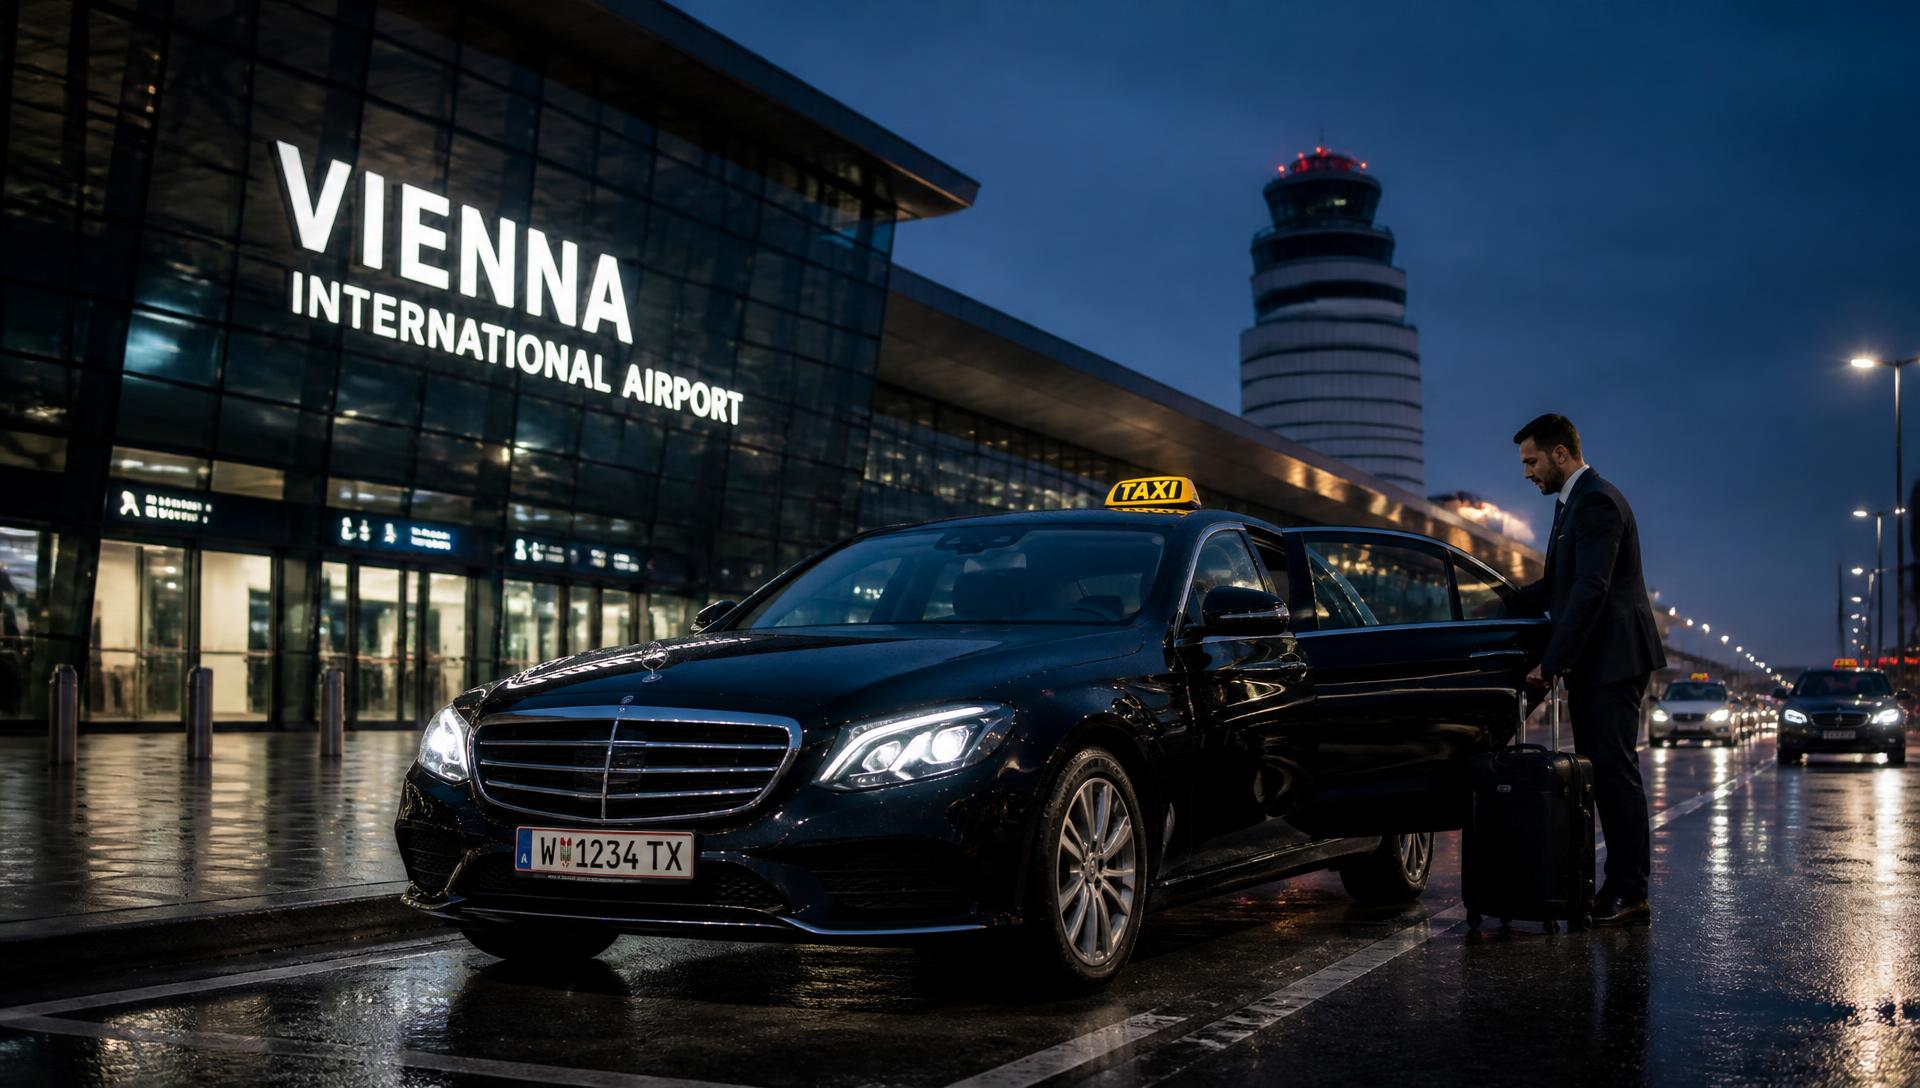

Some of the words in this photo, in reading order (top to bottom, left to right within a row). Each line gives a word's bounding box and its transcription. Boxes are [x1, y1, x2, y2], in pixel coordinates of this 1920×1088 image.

[276, 140, 634, 345] VIENNA
[292, 271, 612, 394] INTERNATIONAL
[621, 363, 744, 426] AIRPORT
[1120, 481, 1178, 500] TAXI
[520, 853, 528, 864] A
[540, 837, 556, 865] W
[575, 839, 639, 870] 1234
[647, 841, 683, 871] TX
